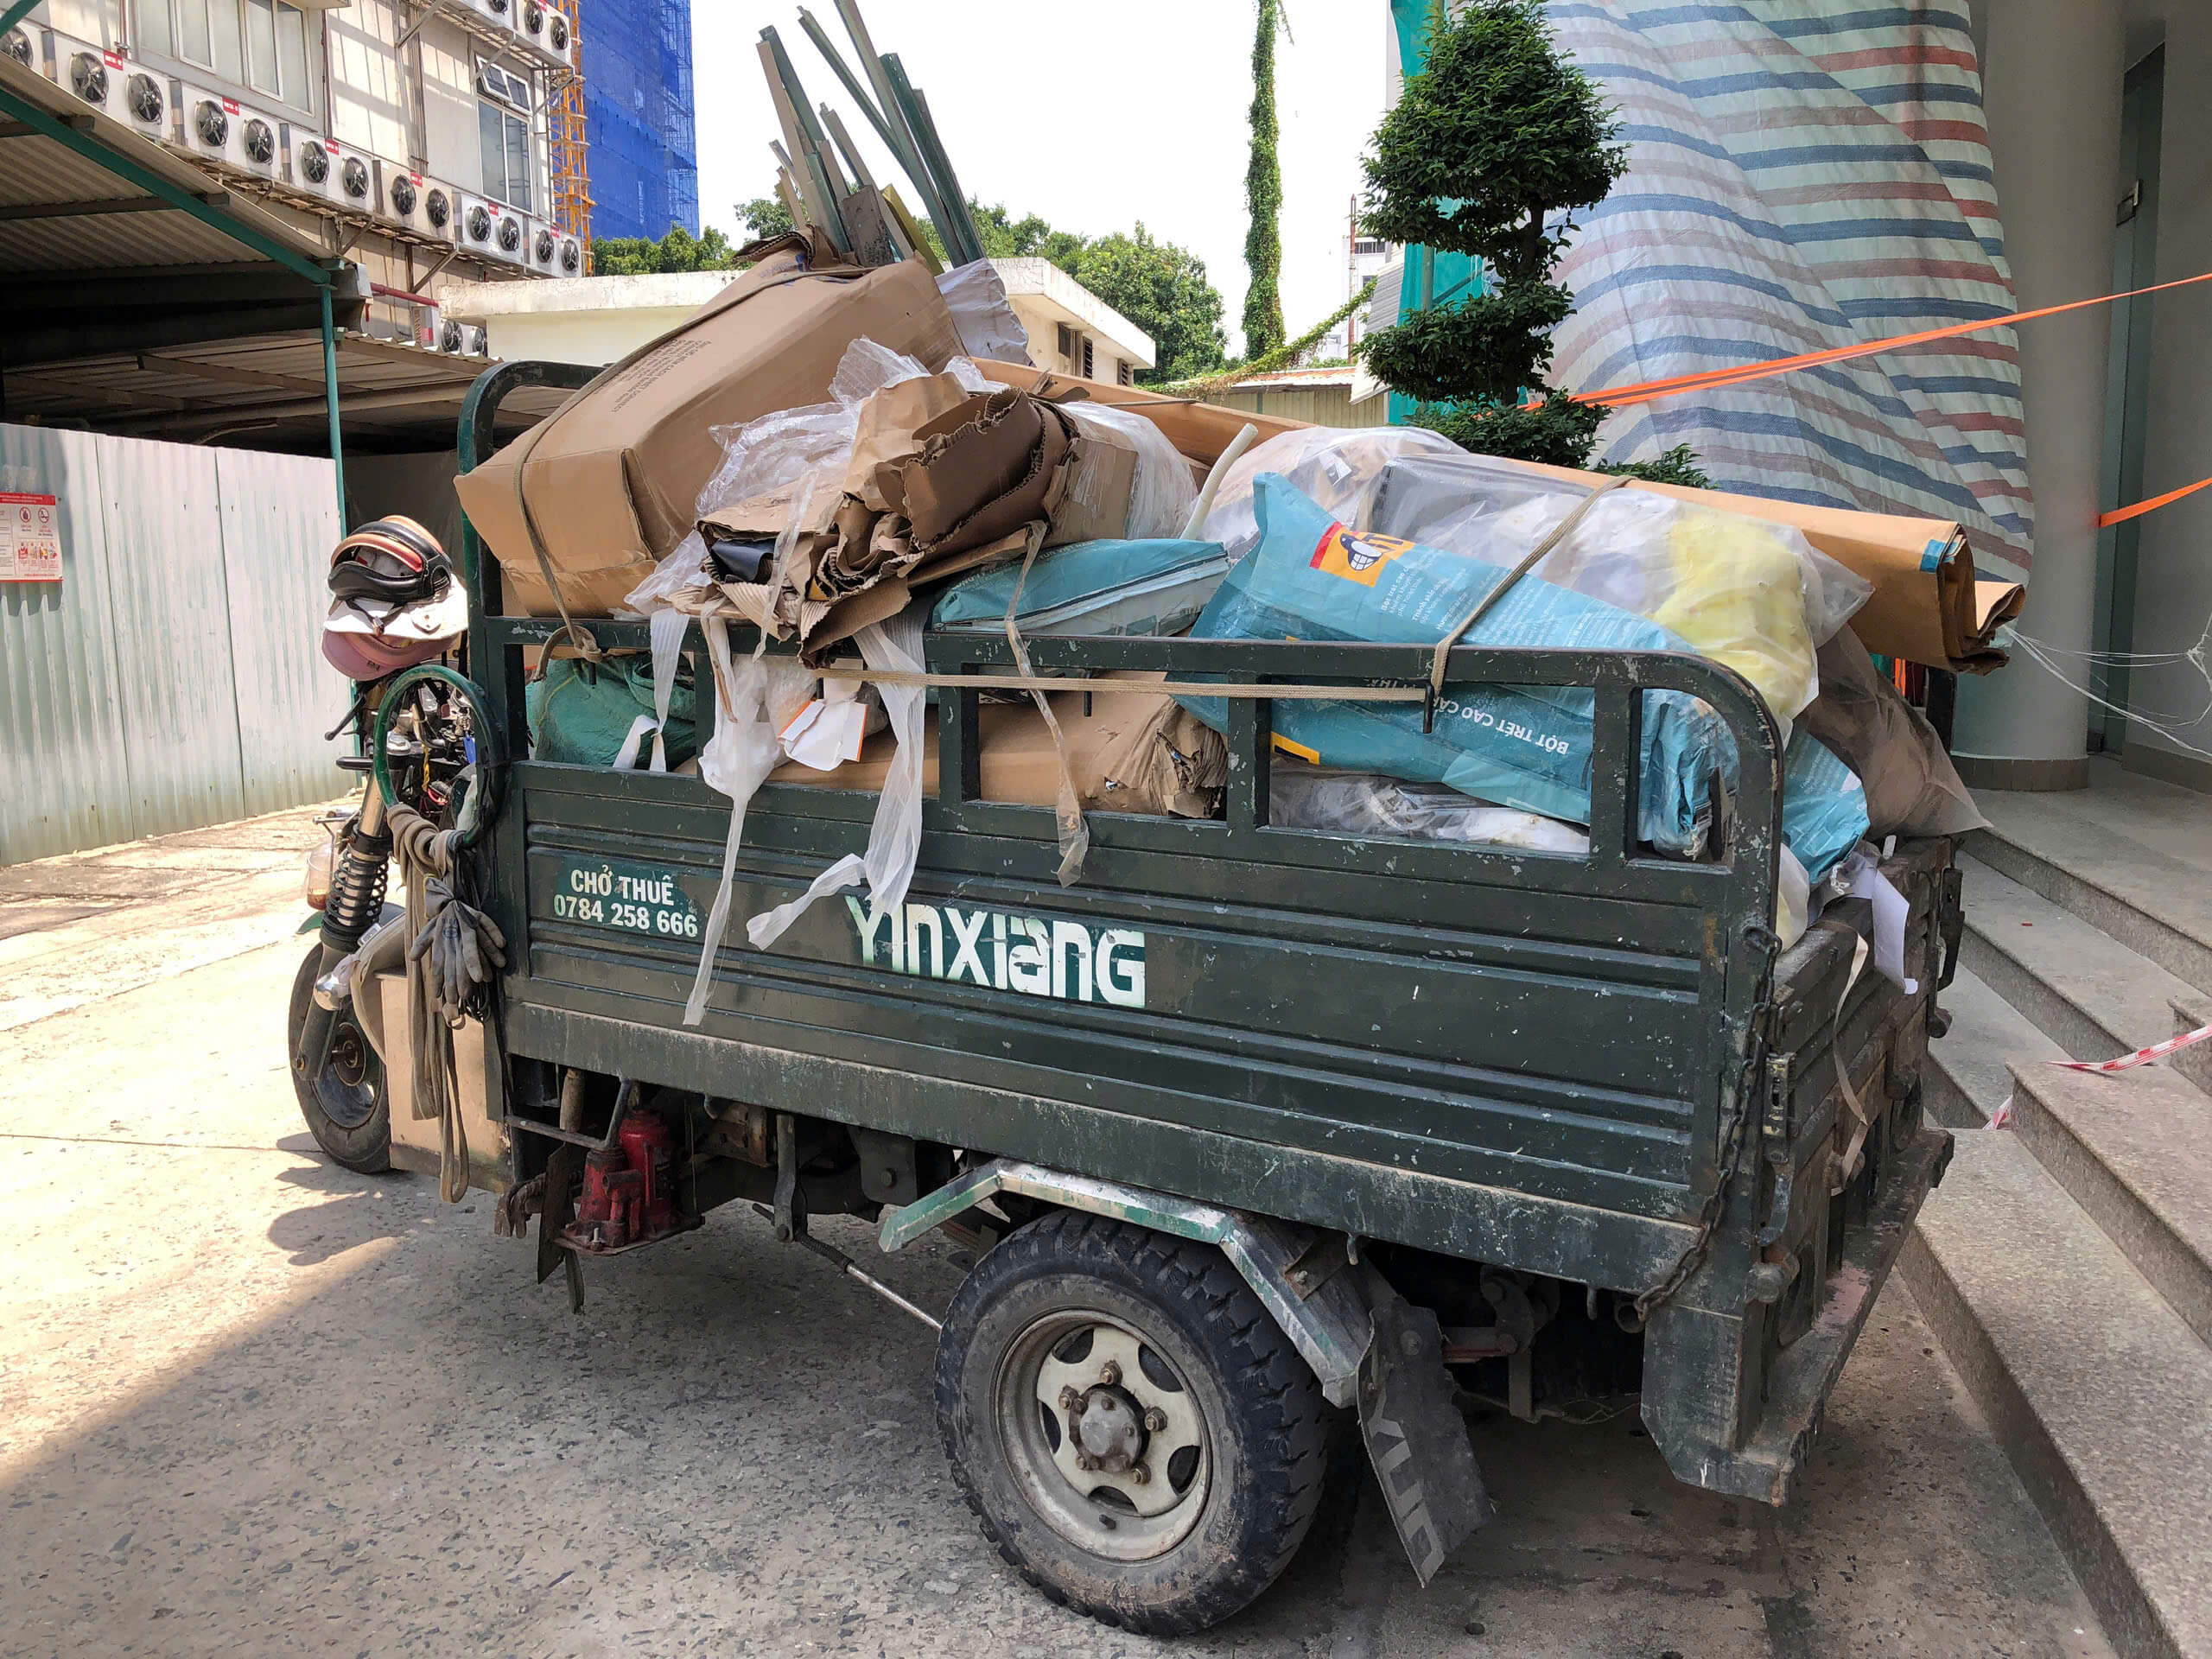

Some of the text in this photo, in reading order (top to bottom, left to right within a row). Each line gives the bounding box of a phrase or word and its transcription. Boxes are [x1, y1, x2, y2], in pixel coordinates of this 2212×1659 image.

[1461, 706, 1495, 727] CAO
[1495, 718, 1536, 743] TRÉT
[1535, 734, 1570, 755] BỘT
[570, 864, 675, 906] CHỞ THUÊ
[553, 893, 698, 938] 0784 258 666
